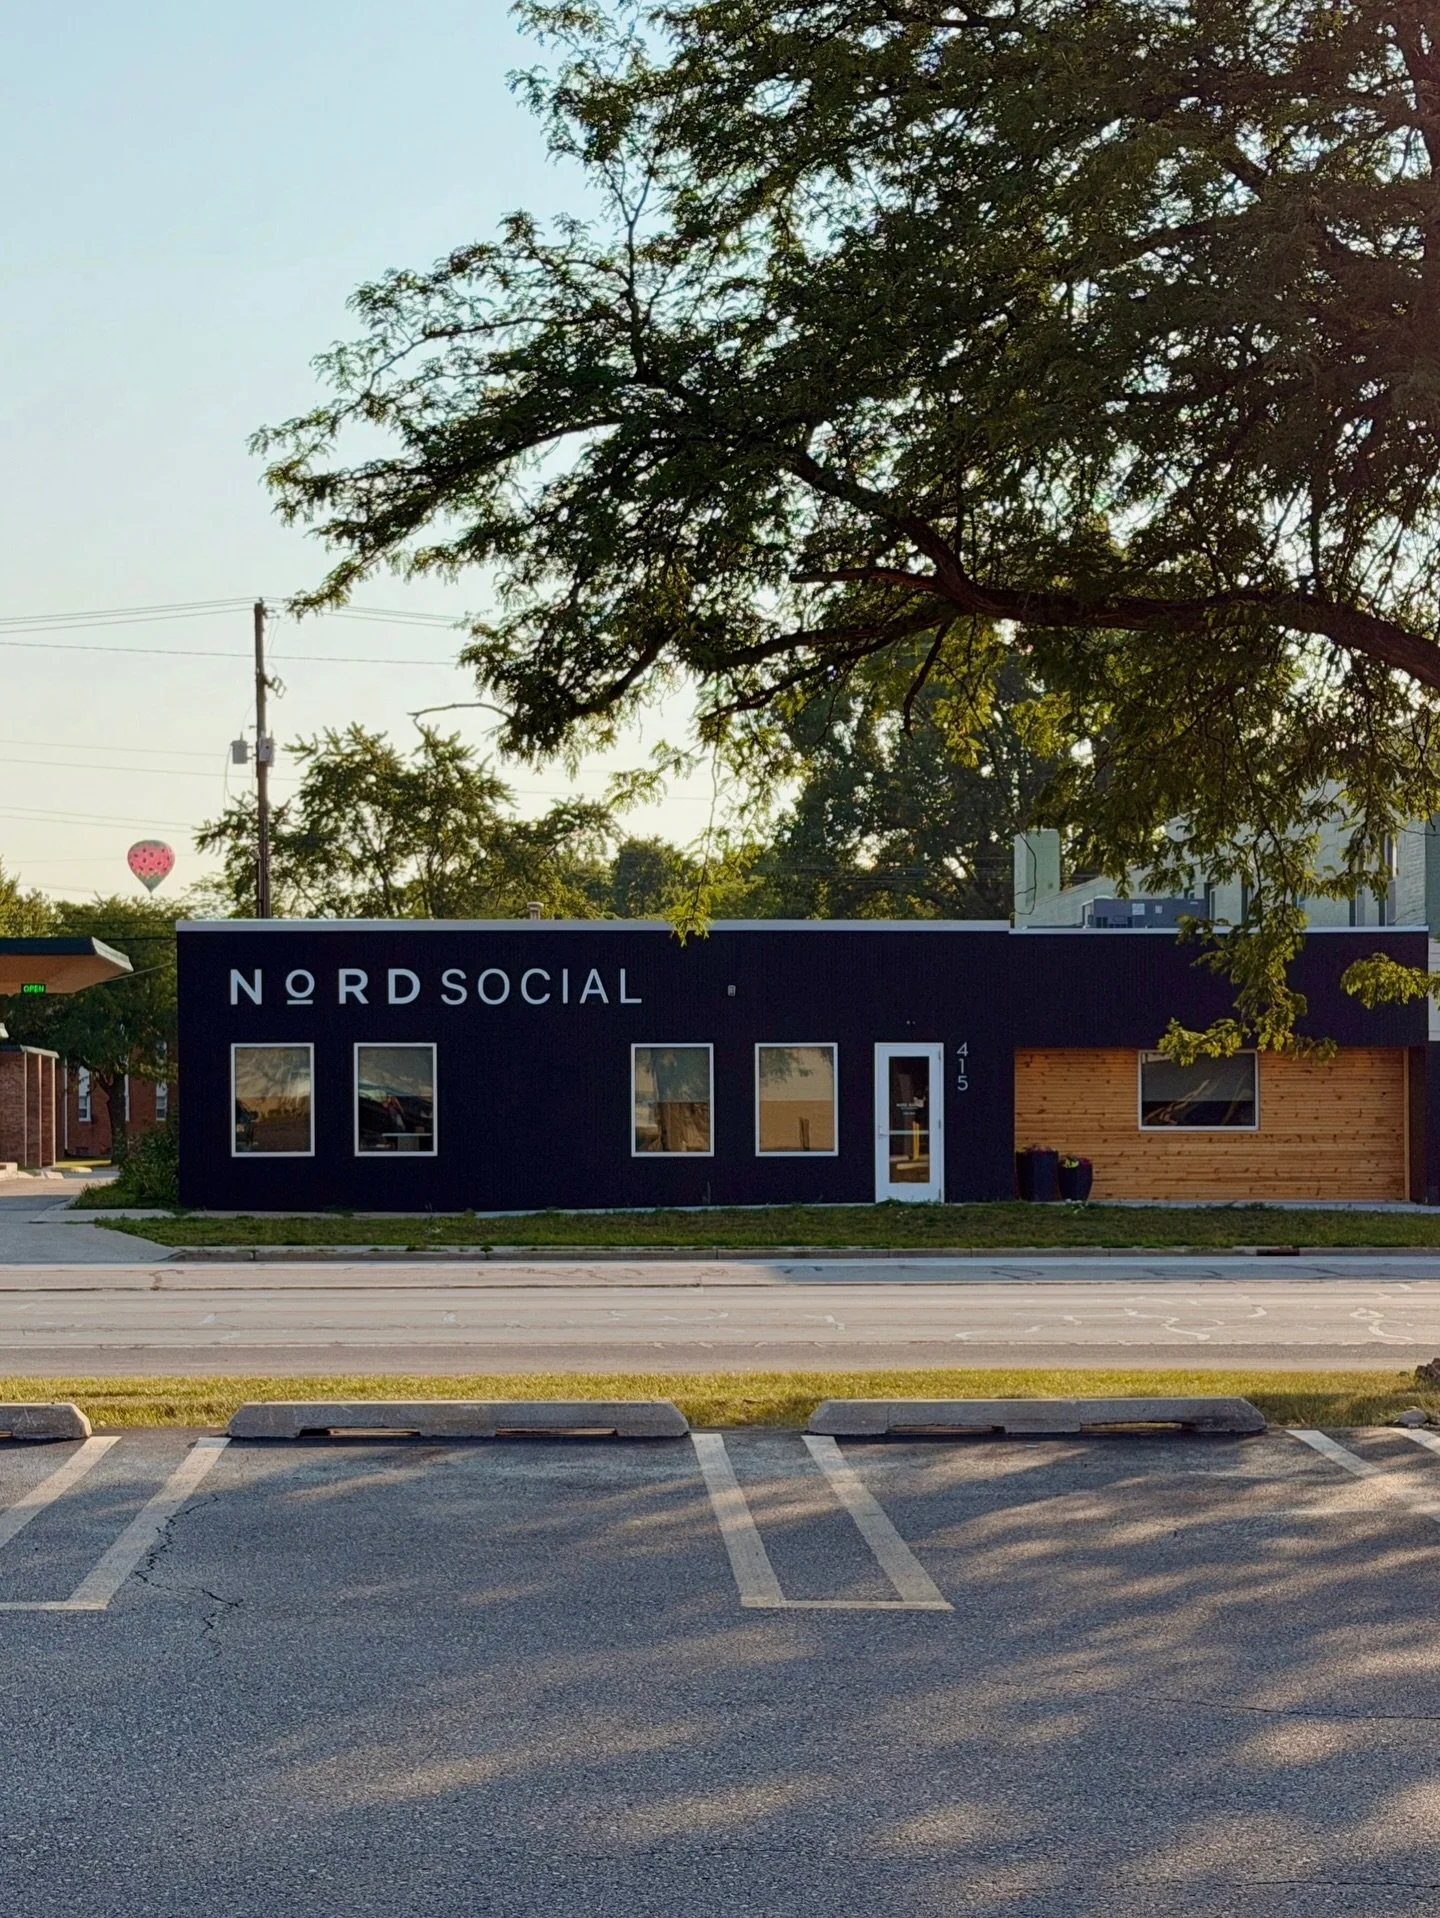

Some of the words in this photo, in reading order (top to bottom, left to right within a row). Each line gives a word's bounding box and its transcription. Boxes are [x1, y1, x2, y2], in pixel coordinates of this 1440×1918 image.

[23, 984, 45, 993] OPEN
[440, 968, 643, 1005] SOCIAL
[956, 1041, 969, 1091] 415
